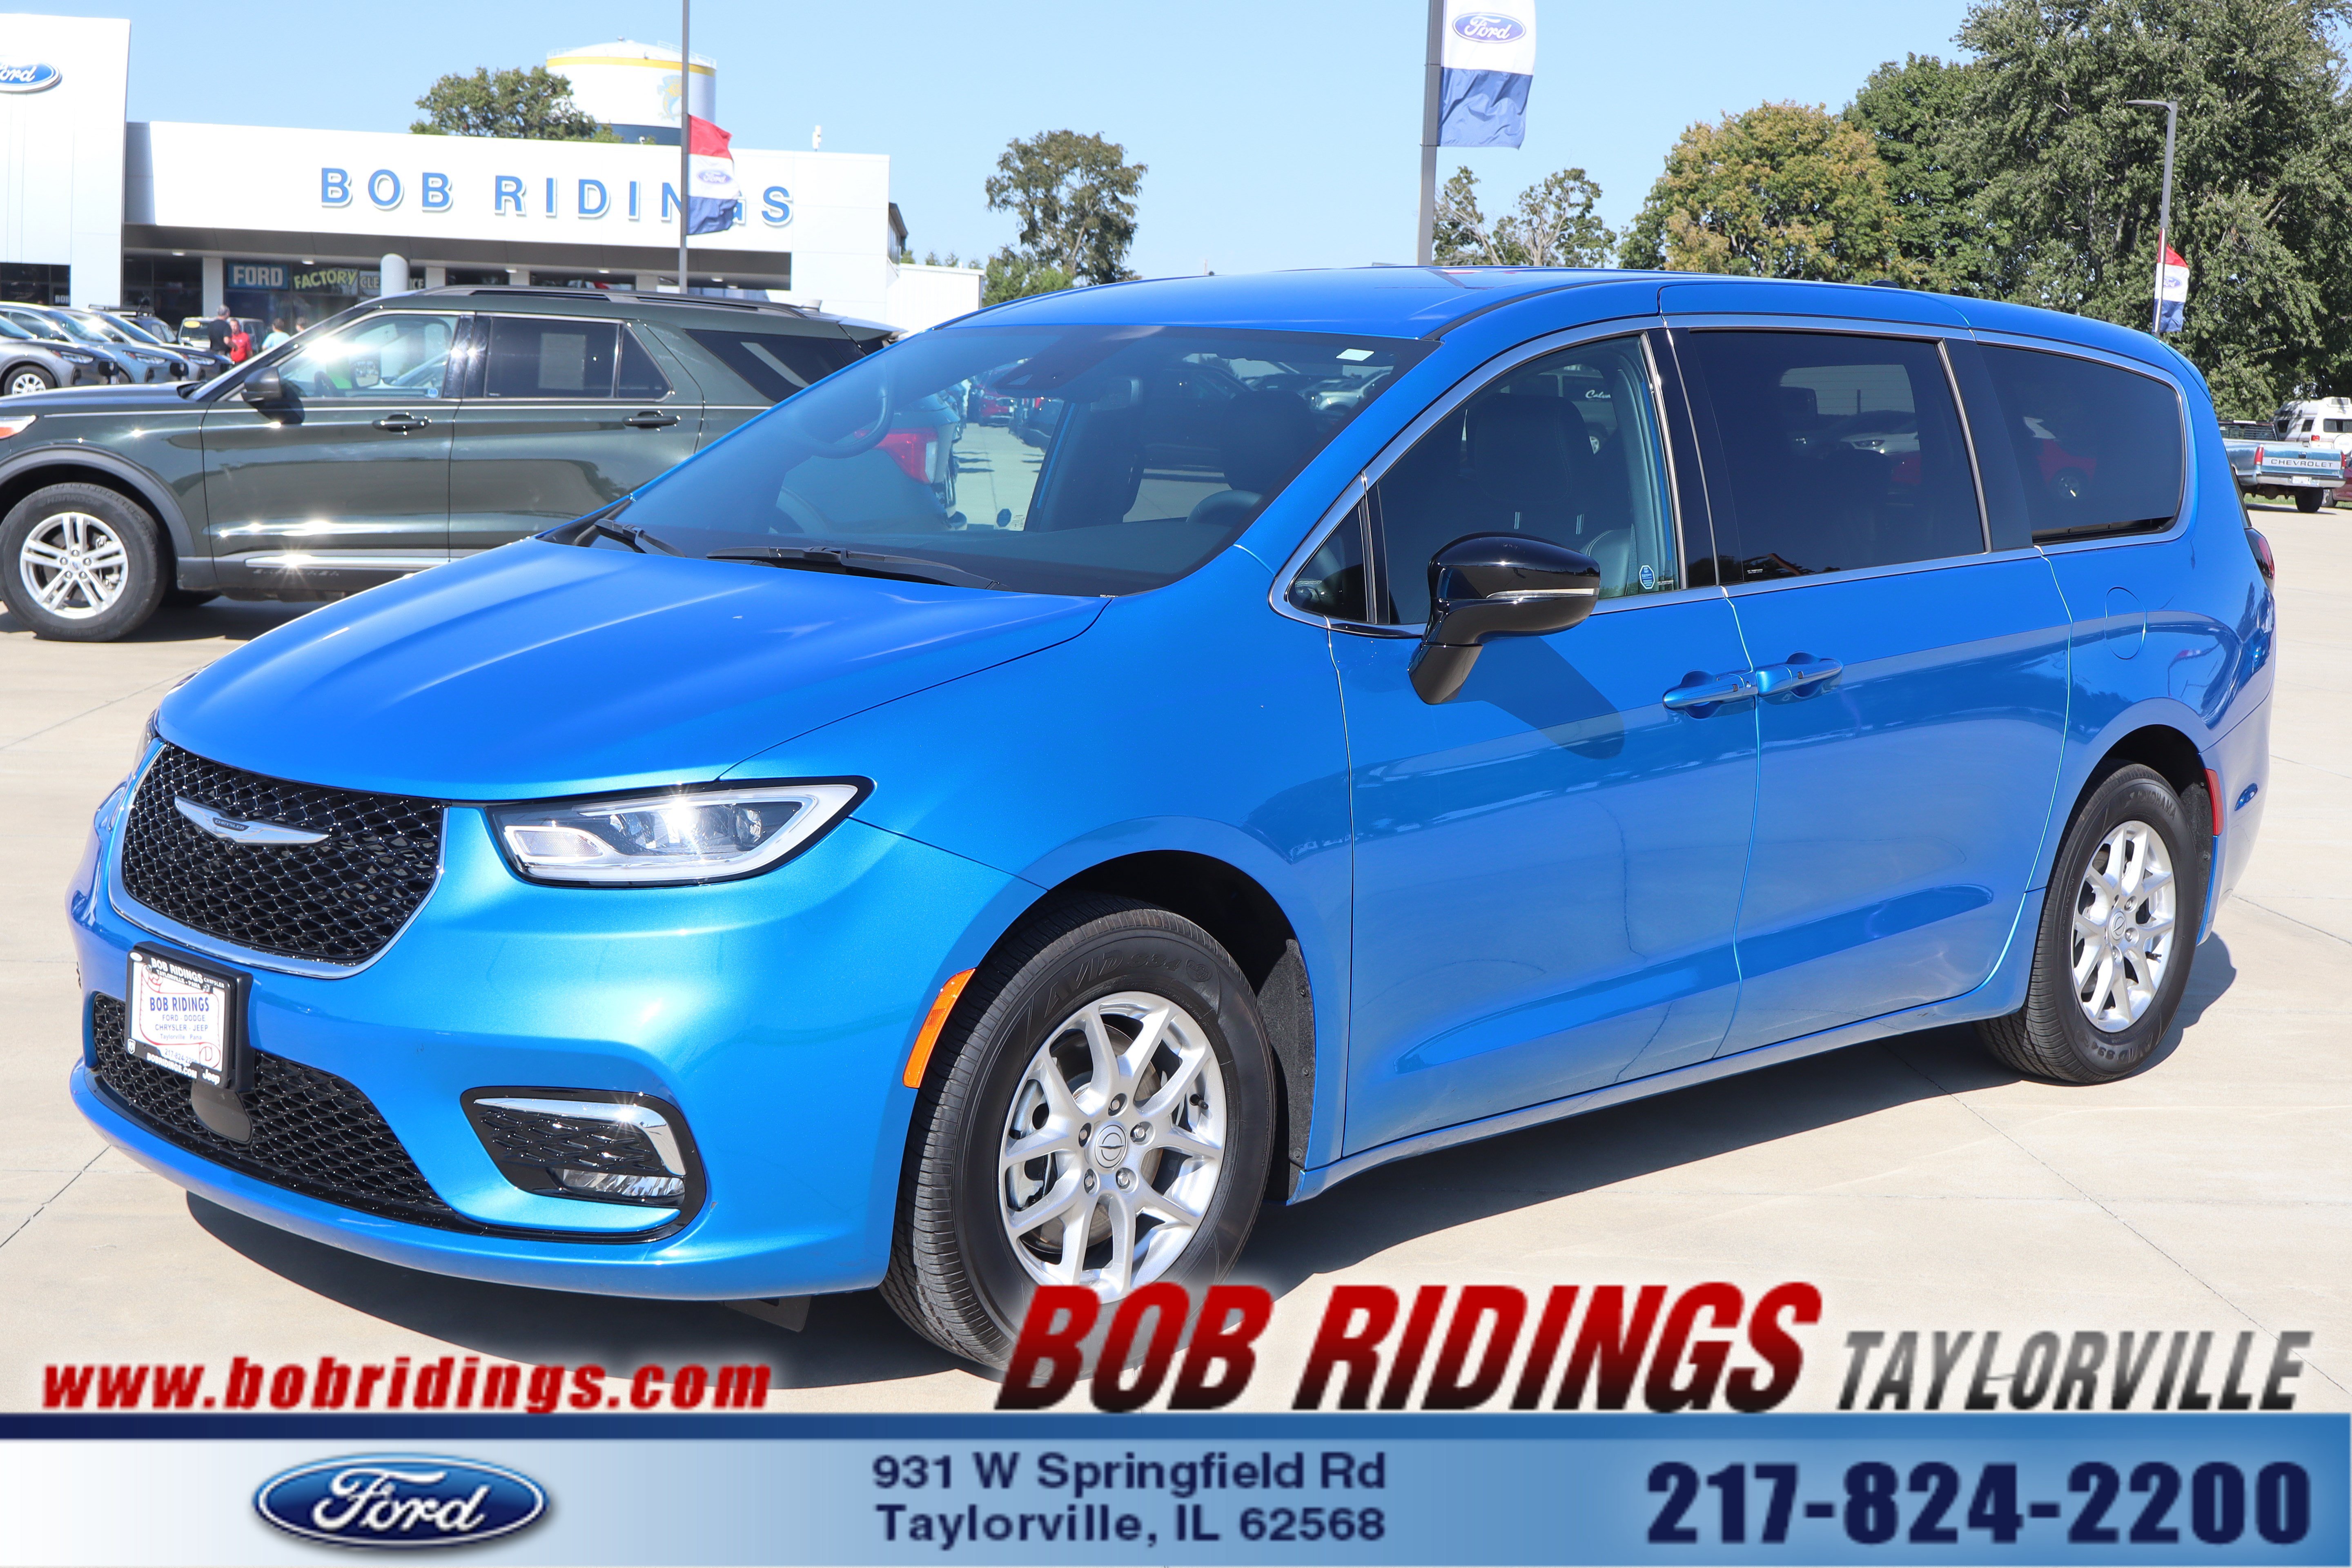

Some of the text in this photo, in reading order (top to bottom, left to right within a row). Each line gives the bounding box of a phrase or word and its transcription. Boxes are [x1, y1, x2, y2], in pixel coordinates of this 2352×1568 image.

[1464, 16, 1512, 40] Ford
[0, 65, 37, 82] ord
[703, 172, 726, 183] Ford
[321, 167, 793, 226] BOB RIDINS
[233, 265, 283, 286] FORD
[294, 270, 359, 290] FACTORY
[2271, 459, 2333, 468] CHEVROLET
[215, 819, 245, 830] CHRYSLER
[150, 957, 204, 984] BOB RIDINGS
[156, 969, 185, 984] TAYLORVILLE
[188, 981, 201, 989] PANA
[204, 977, 225, 989] CHRYSLER
[150, 997, 209, 1012] BOB RIDINGS
[146, 1052, 197, 1079] BOBRIDINGS.COM
[203, 1069, 220, 1085] Jeep
